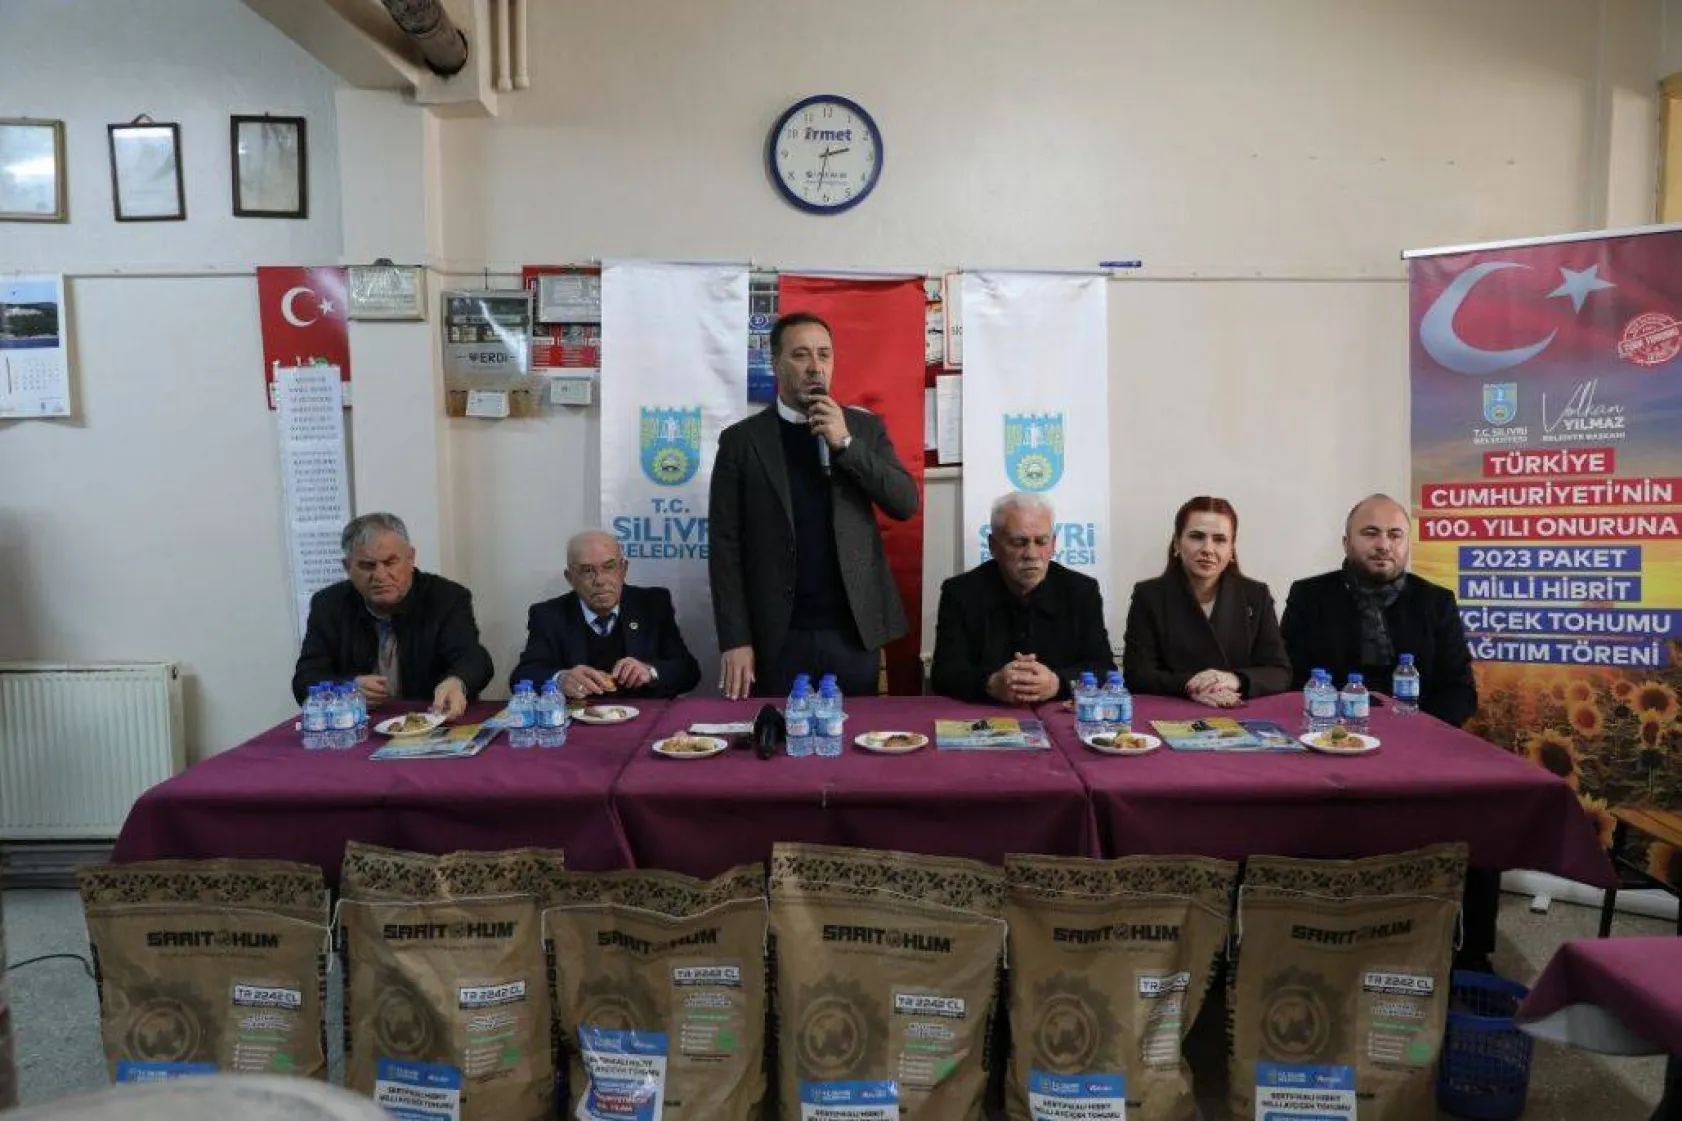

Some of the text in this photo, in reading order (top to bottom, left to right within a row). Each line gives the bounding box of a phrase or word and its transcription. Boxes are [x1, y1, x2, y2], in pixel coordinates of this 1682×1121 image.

[1563, 417, 1625, 431] YILMAZ
[1491, 449, 1605, 474] TÜRKİYE
[1430, 478, 1673, 507] CUMHURİYETİ'NİN
[652, 499, 690, 514] T.C.
[1426, 515, 1678, 537] 100. YILI ONURUNA
[1472, 548, 1628, 568] 2023 PAKET
[1468, 575, 1631, 601] MİLLİ HİBRİT
[1460, 606, 1671, 634] ÇİÇEK TOHUMU
[1562, 640, 1659, 666] TÖRENİ
[1143, 980, 1159, 992] TR
[1417, 979, 1431, 989] CL
[947, 999, 962, 1010] CL
